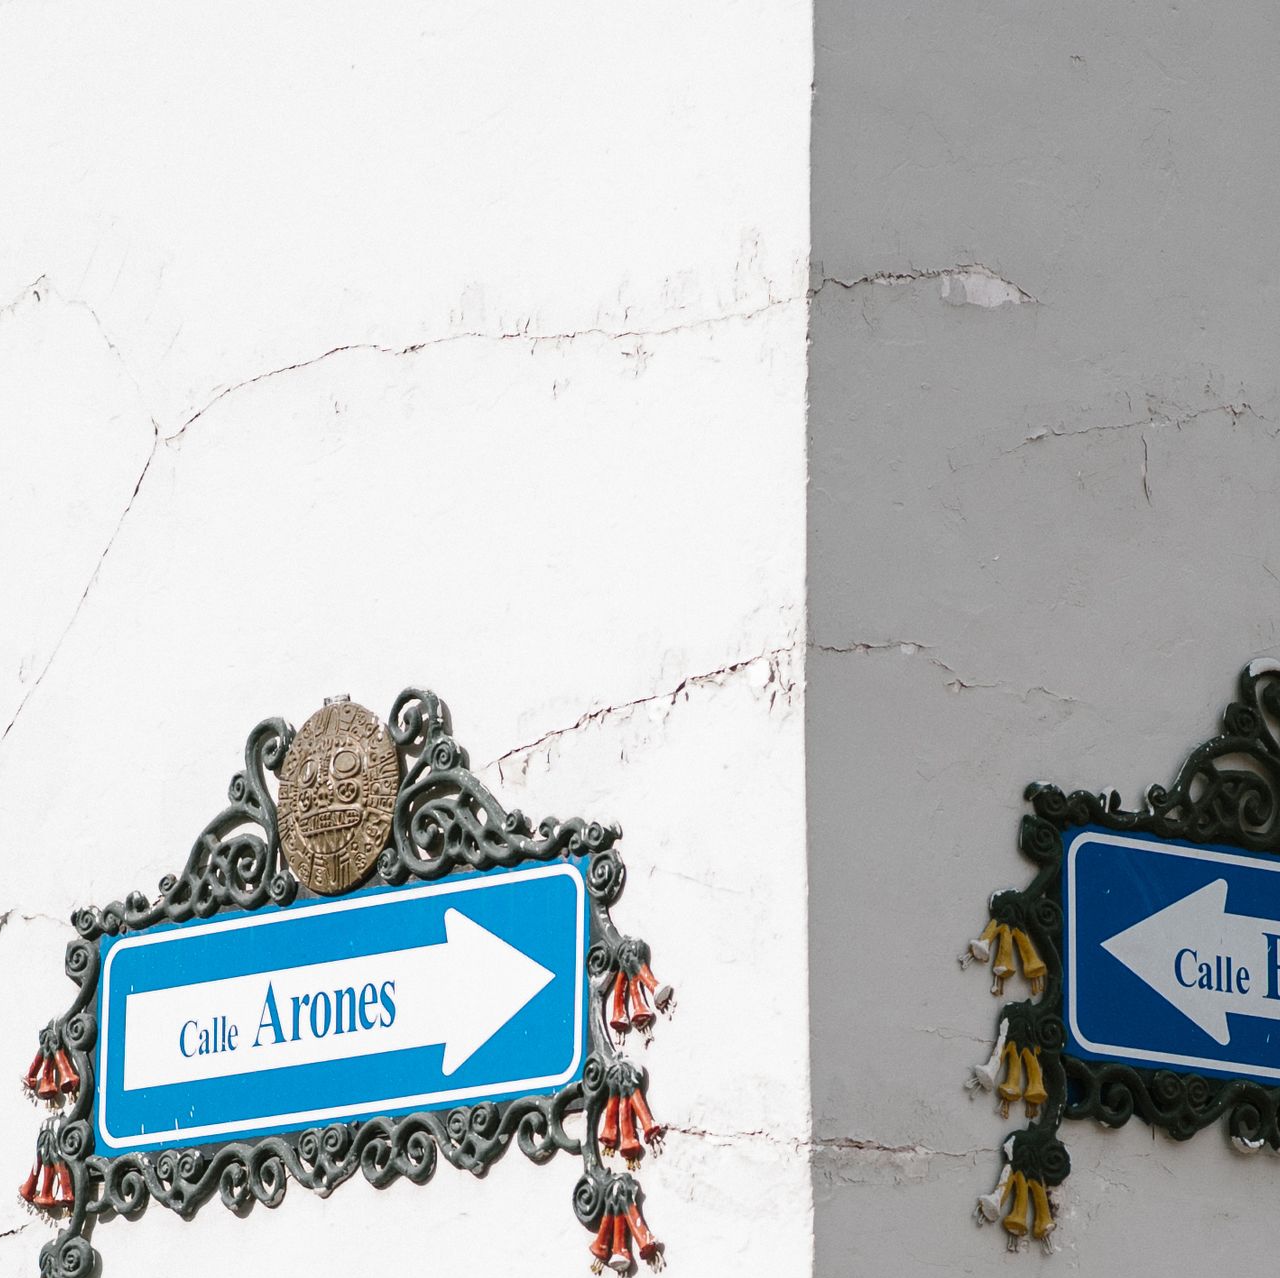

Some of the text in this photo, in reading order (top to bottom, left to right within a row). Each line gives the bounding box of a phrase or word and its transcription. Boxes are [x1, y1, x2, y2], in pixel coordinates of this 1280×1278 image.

[1174, 948, 1250, 995] Calle
[179, 980, 396, 1058] Calle Arones
